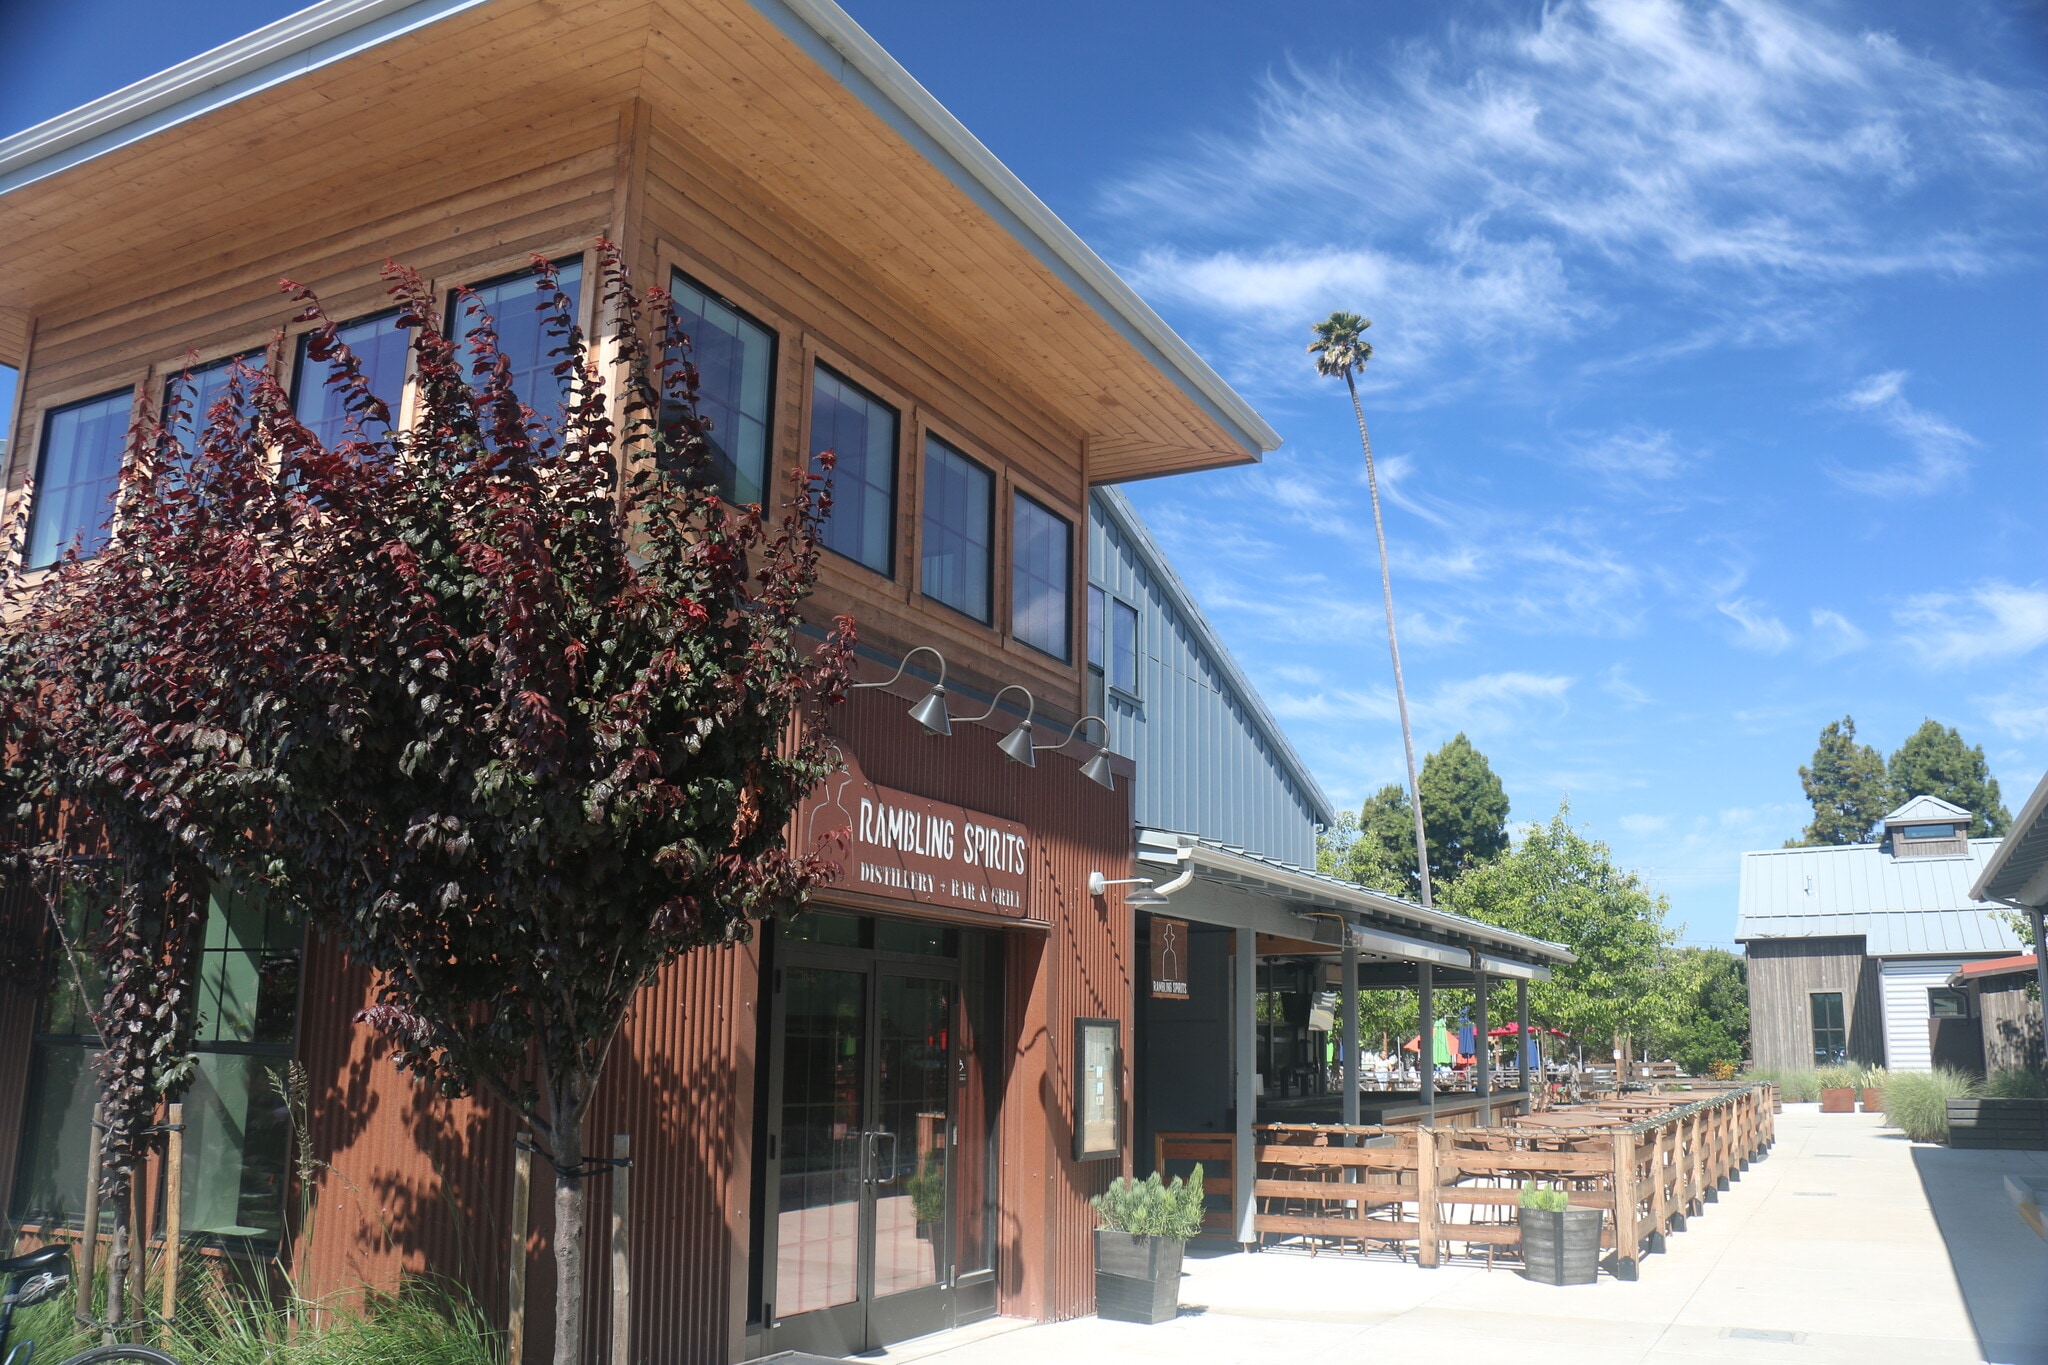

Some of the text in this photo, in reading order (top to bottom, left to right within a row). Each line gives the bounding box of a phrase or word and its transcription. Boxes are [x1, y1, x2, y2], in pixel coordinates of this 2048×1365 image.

[859, 797, 1026, 876] RAMBLING SPIRITS
[860, 861, 935, 893] DISTILLERY
[951, 878, 976, 901] BAR
[979, 885, 987, 903] &
[991, 887, 1022, 909] GRILL
[1153, 980, 1187, 994] RAMBLING SPIRITS
